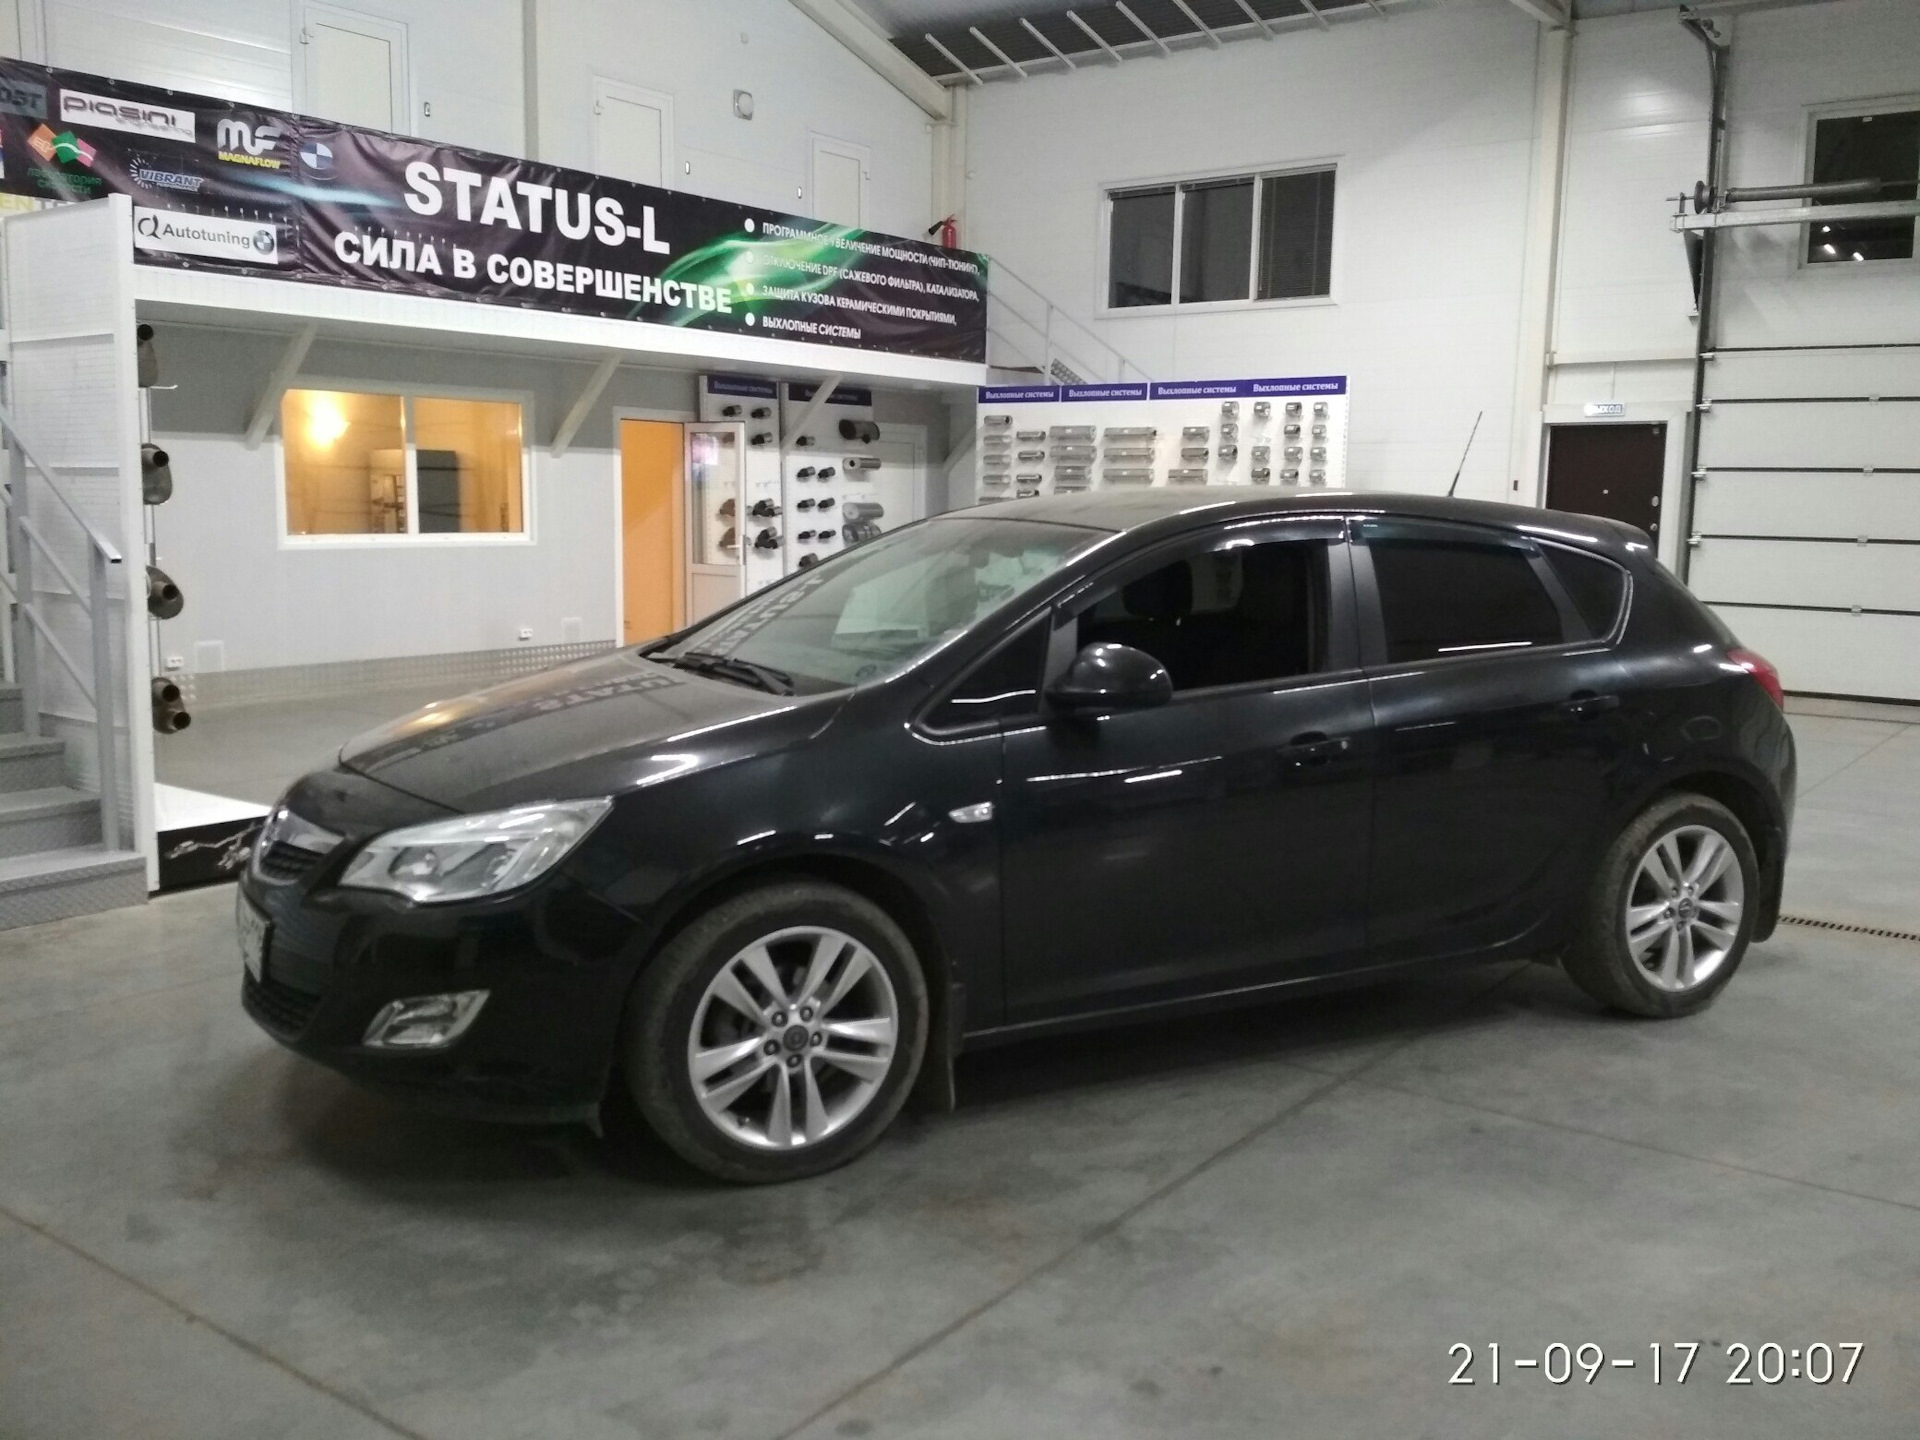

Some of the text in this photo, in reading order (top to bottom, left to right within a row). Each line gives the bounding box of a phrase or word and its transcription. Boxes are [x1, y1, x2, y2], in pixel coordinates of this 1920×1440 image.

[217, 151, 281, 169] MAGNAFLOW
[139, 169, 204, 188] VIBRANT
[404, 160, 670, 255] STATUS-L
[163, 224, 250, 248] Autotuning
[881, 246, 928, 264] МОЩНОСТИ
[334, 230, 732, 313] СИЛА В СОВЕРШЕНСТВЕ
[763, 255, 821, 275] ОТКЛЮЧЕНИЕ
[839, 268, 887, 286] (САЖЕВОГО
[887, 276, 926, 294] ФИЛЬТРА),
[926, 283, 980, 302] КАТАЛИЗАТОРА,
[762, 286, 957, 326] ЗАЩИТА КУЗОВА КЕРАМИЧЕСКИМИ ПОКРЫТИЯМИ,
[762, 316, 862, 339] ВЫХЛОПНЫЕ СИСТЕМЫ
[1068, 388, 1143, 398] Выхлопные системы
[1157, 386, 1237, 395] Выхлопные системы
[1253, 382, 1339, 392] Выхлопные системы
